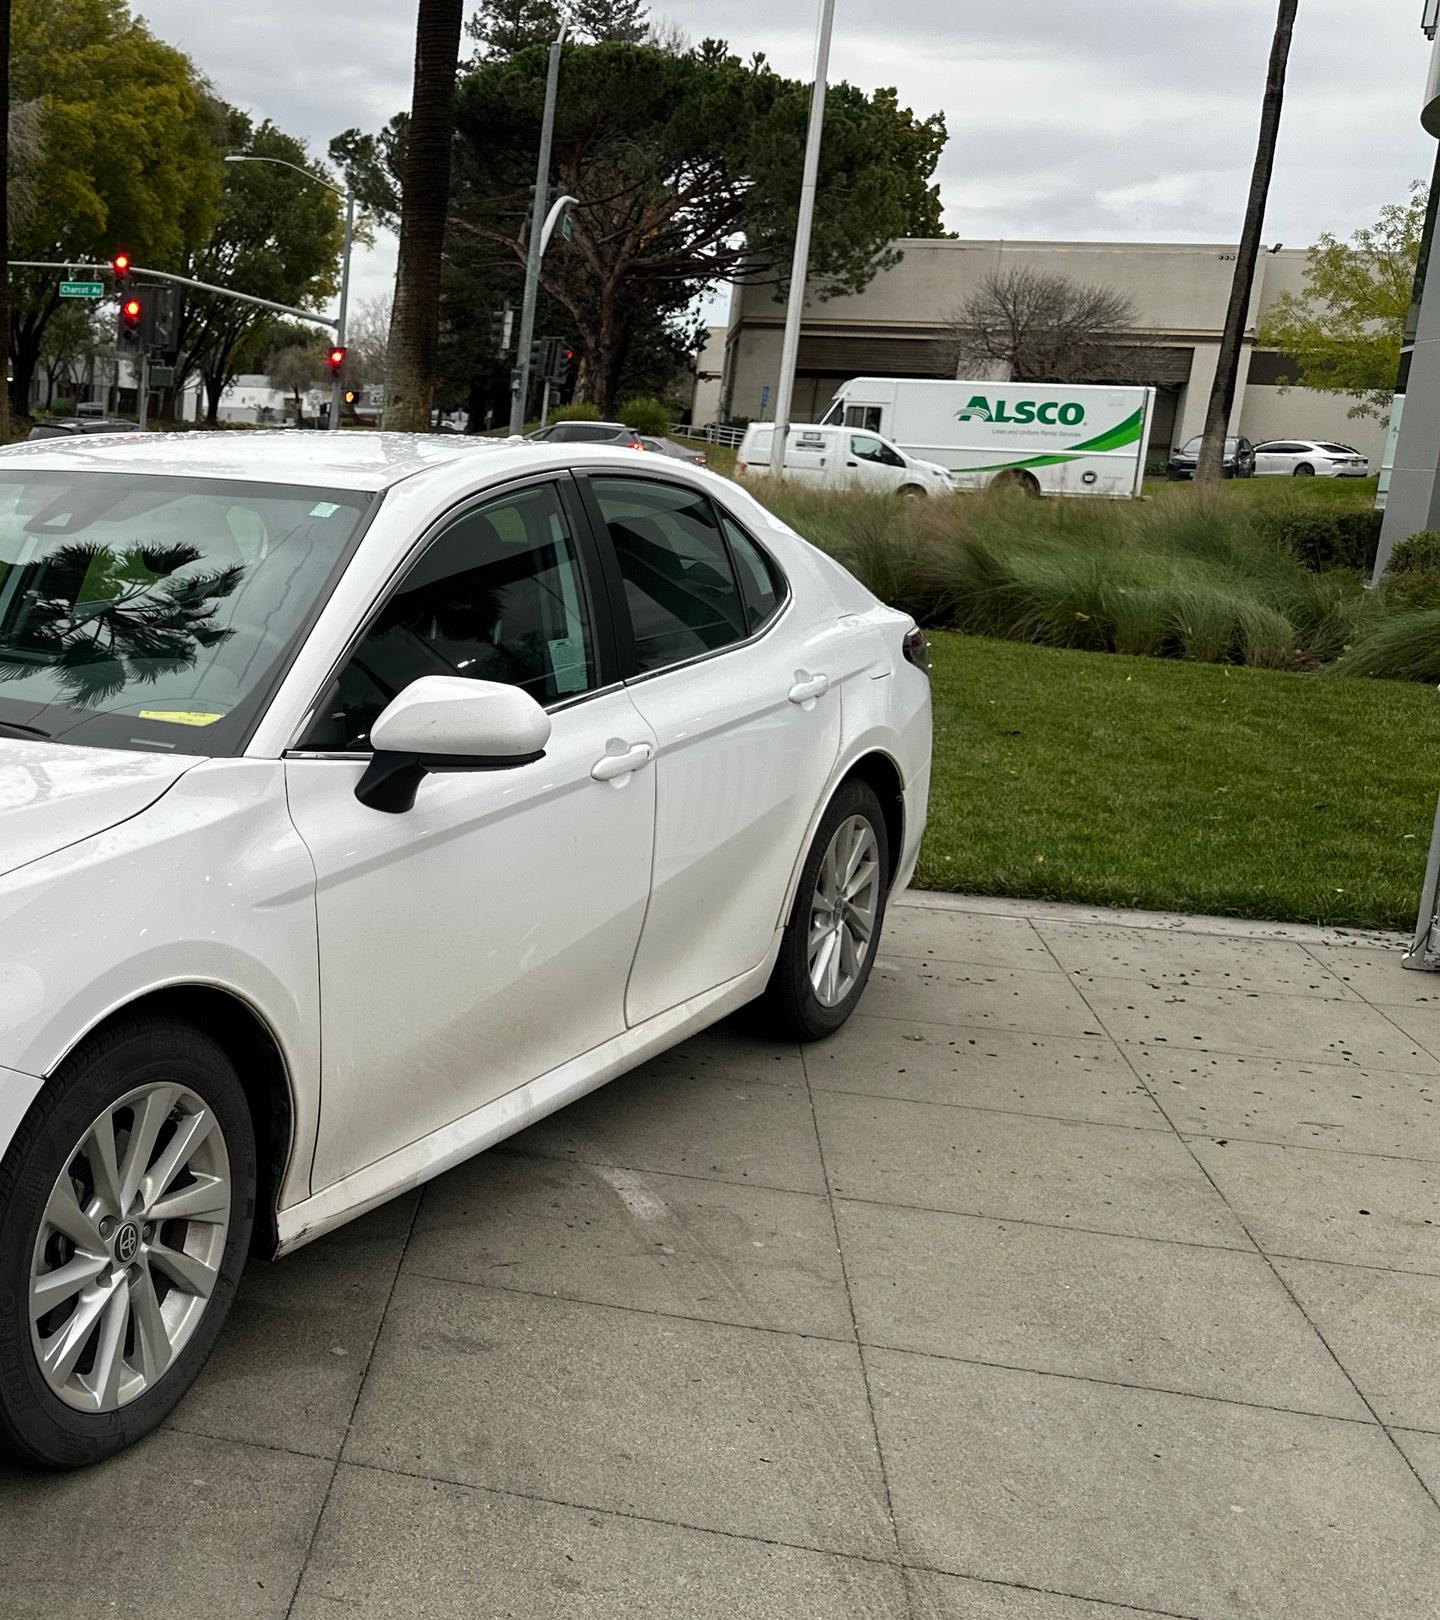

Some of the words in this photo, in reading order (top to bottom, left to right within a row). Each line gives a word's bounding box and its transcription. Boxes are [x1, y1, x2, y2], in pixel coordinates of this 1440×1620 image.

[62, 285, 89, 294] Charcot
[91, 286, 101, 294] Av
[955, 396, 1085, 426] ALSCO
